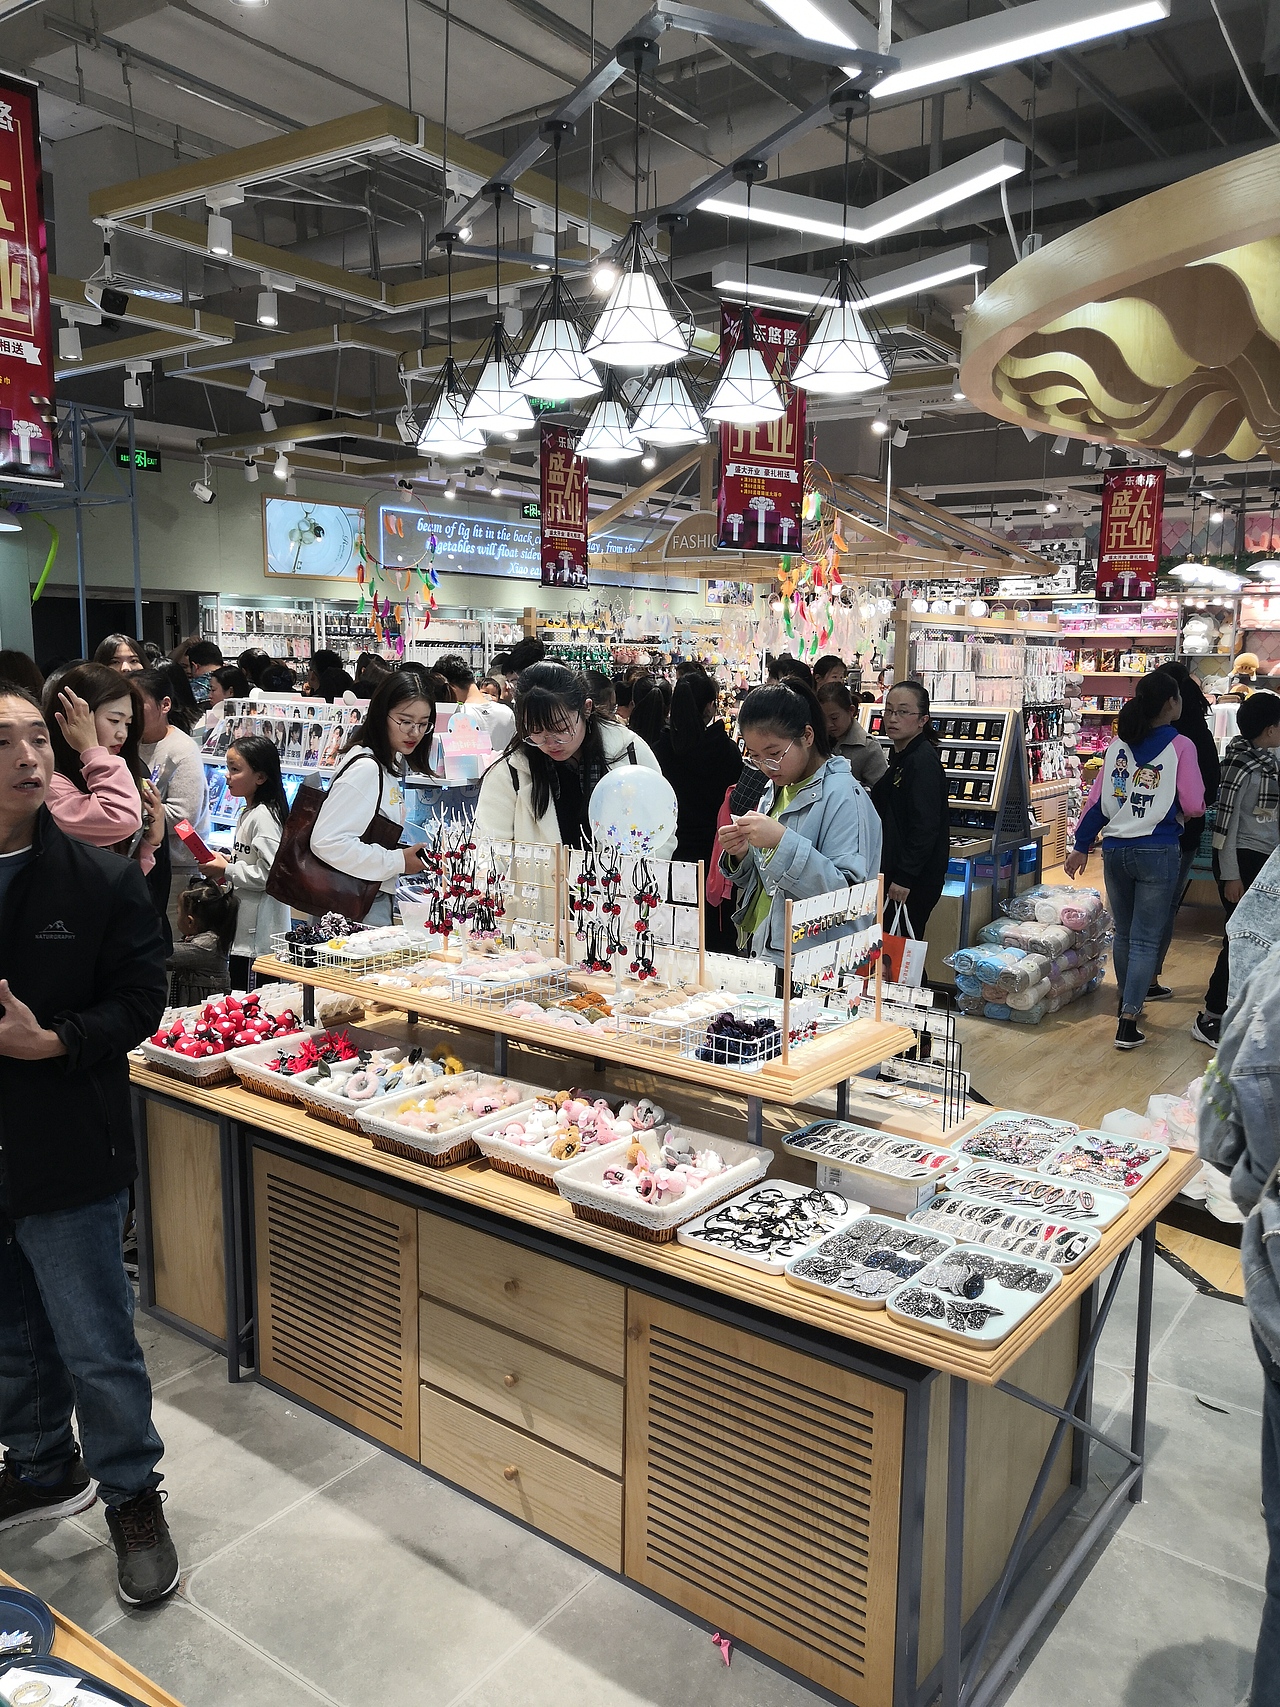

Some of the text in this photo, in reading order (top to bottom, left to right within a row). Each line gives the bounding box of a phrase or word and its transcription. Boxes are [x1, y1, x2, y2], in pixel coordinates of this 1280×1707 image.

[1109, 488, 1152, 529] 盛大
[444, 522, 458, 538] of
[485, 526, 495, 539] in
[497, 526, 510, 541] the
[606, 541, 623, 554] from
[1107, 520, 1152, 549] 开业
[477, 542, 497, 556] will
[494, 544, 519, 560] float
[507, 562, 529, 576] Xiao
